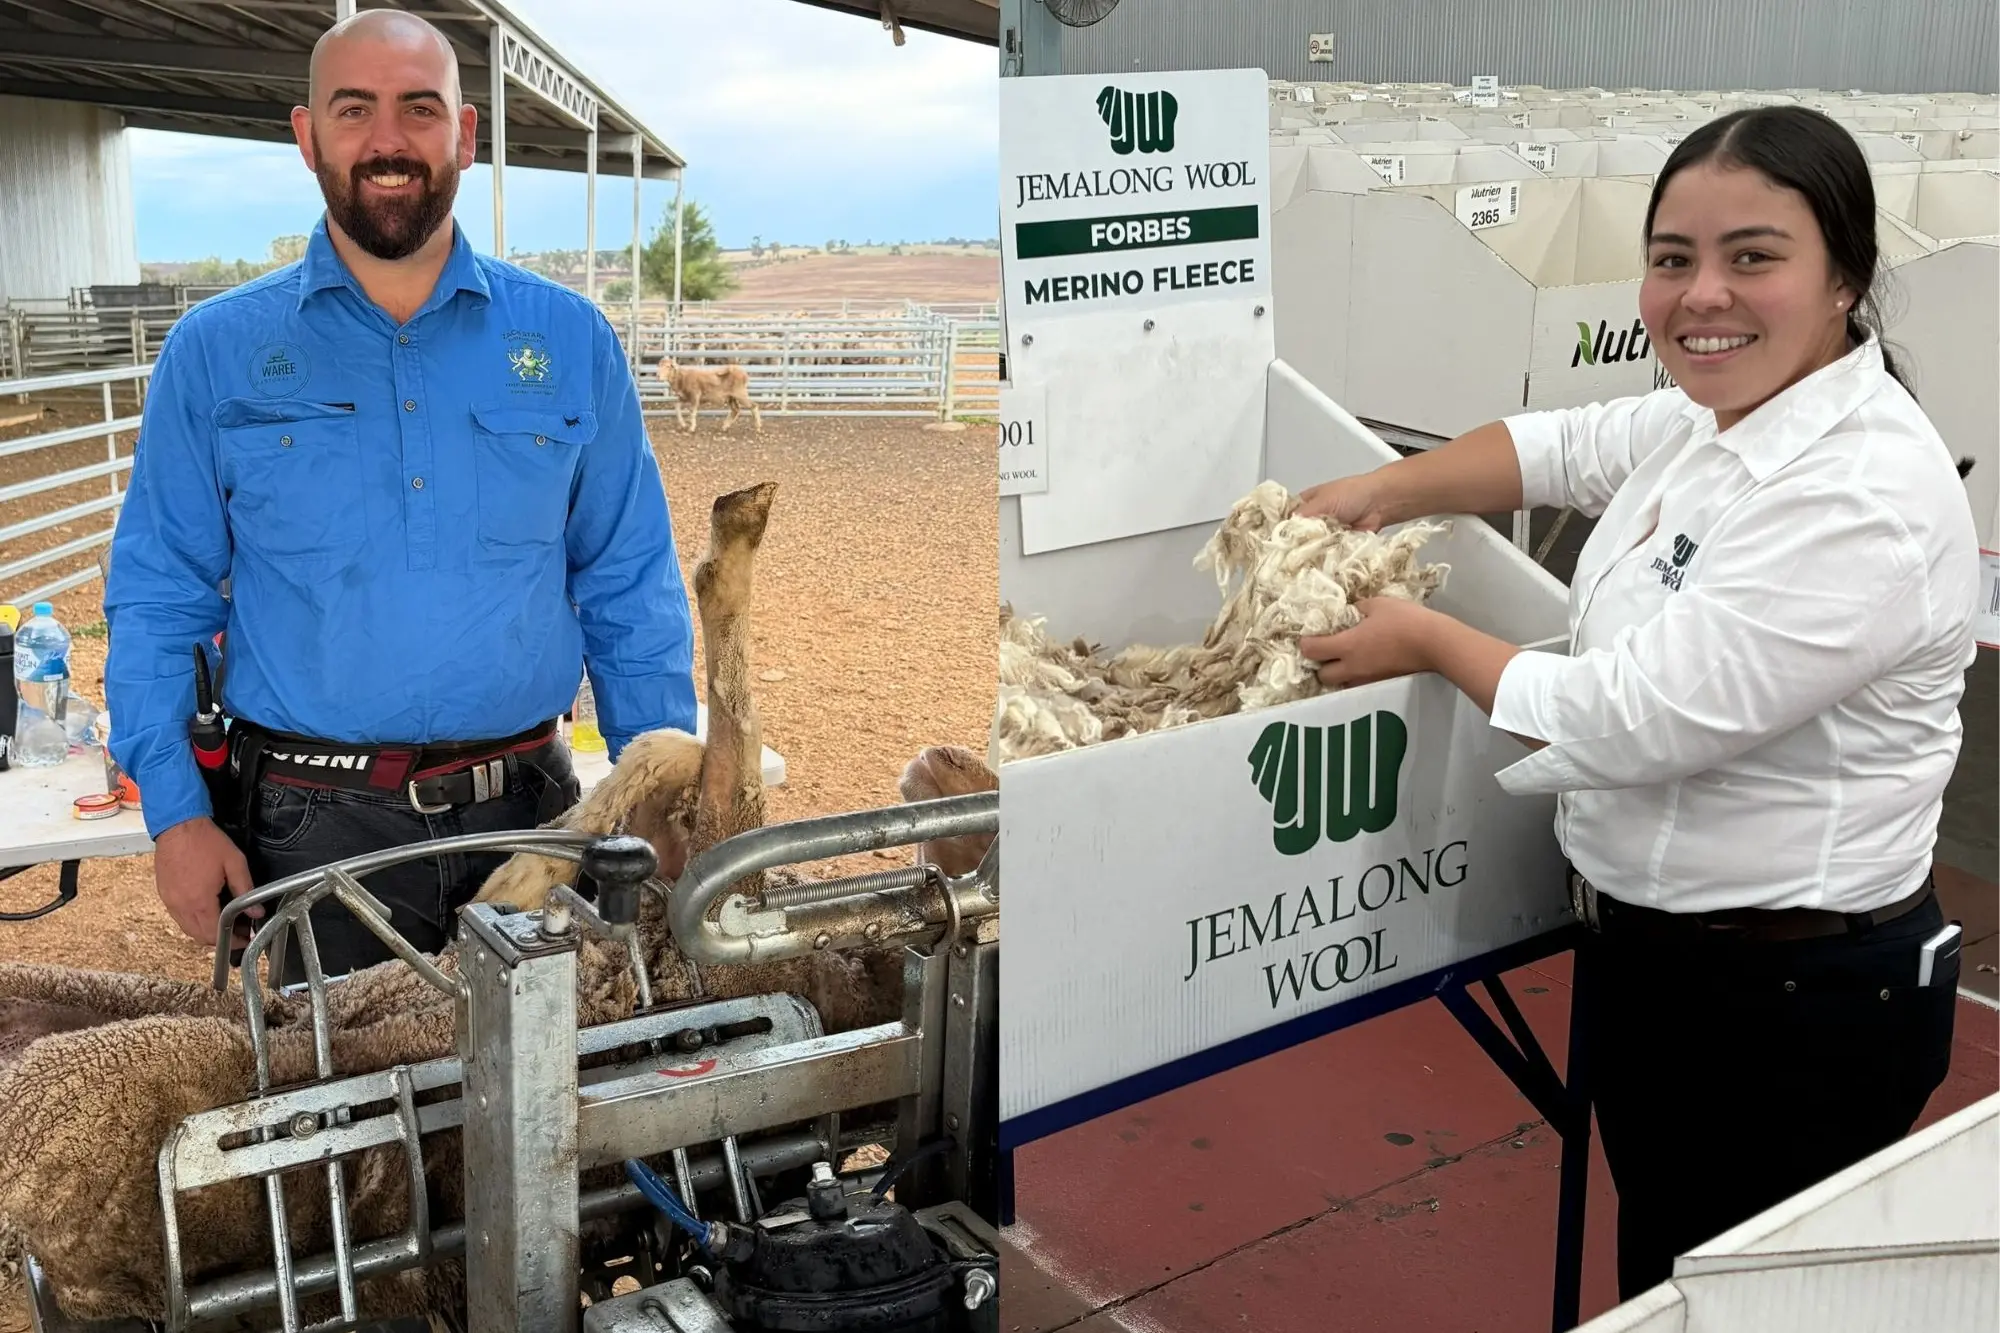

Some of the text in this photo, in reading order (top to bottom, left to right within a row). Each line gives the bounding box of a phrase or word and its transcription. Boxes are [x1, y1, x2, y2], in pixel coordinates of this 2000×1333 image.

[1016, 161, 1256, 208] JEMALONG WOOL
[1471, 185, 1501, 199] Nutrien
[1091, 216, 1192, 247] FORBES
[1471, 208, 1500, 227] 2365
[1024, 258, 1255, 305] MERINO FLEECE
[262, 362, 297, 378] WAREE
[1011, 469, 1038, 480] WOOL
[1184, 840, 1470, 982] JEMALONG
[1262, 928, 1399, 1010] WOOL
